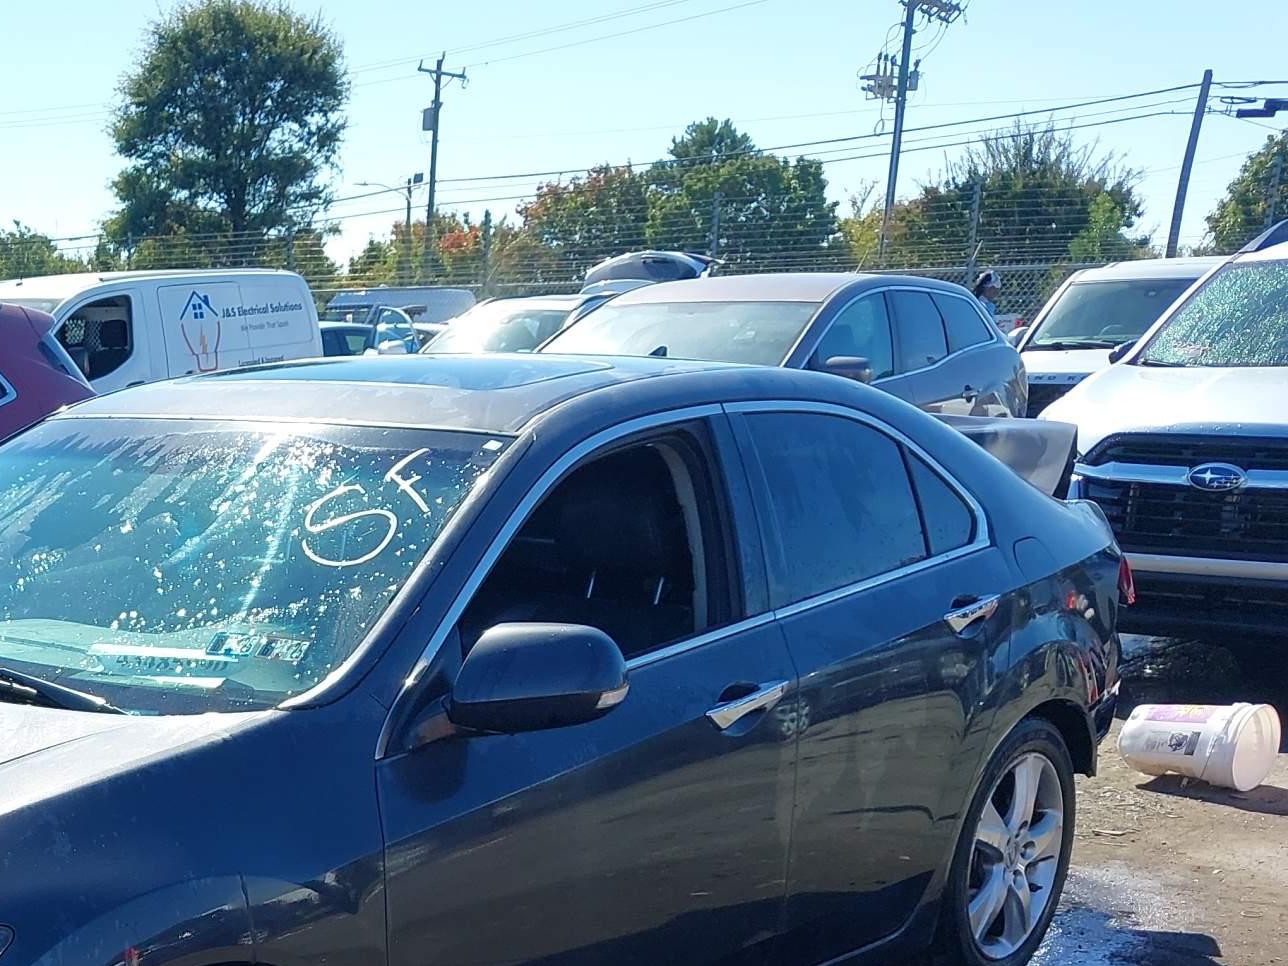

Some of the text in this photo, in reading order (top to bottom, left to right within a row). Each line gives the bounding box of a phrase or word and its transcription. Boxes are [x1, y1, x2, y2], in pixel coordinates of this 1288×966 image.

[222, 301, 303, 319] J&S Electrical Solutions
